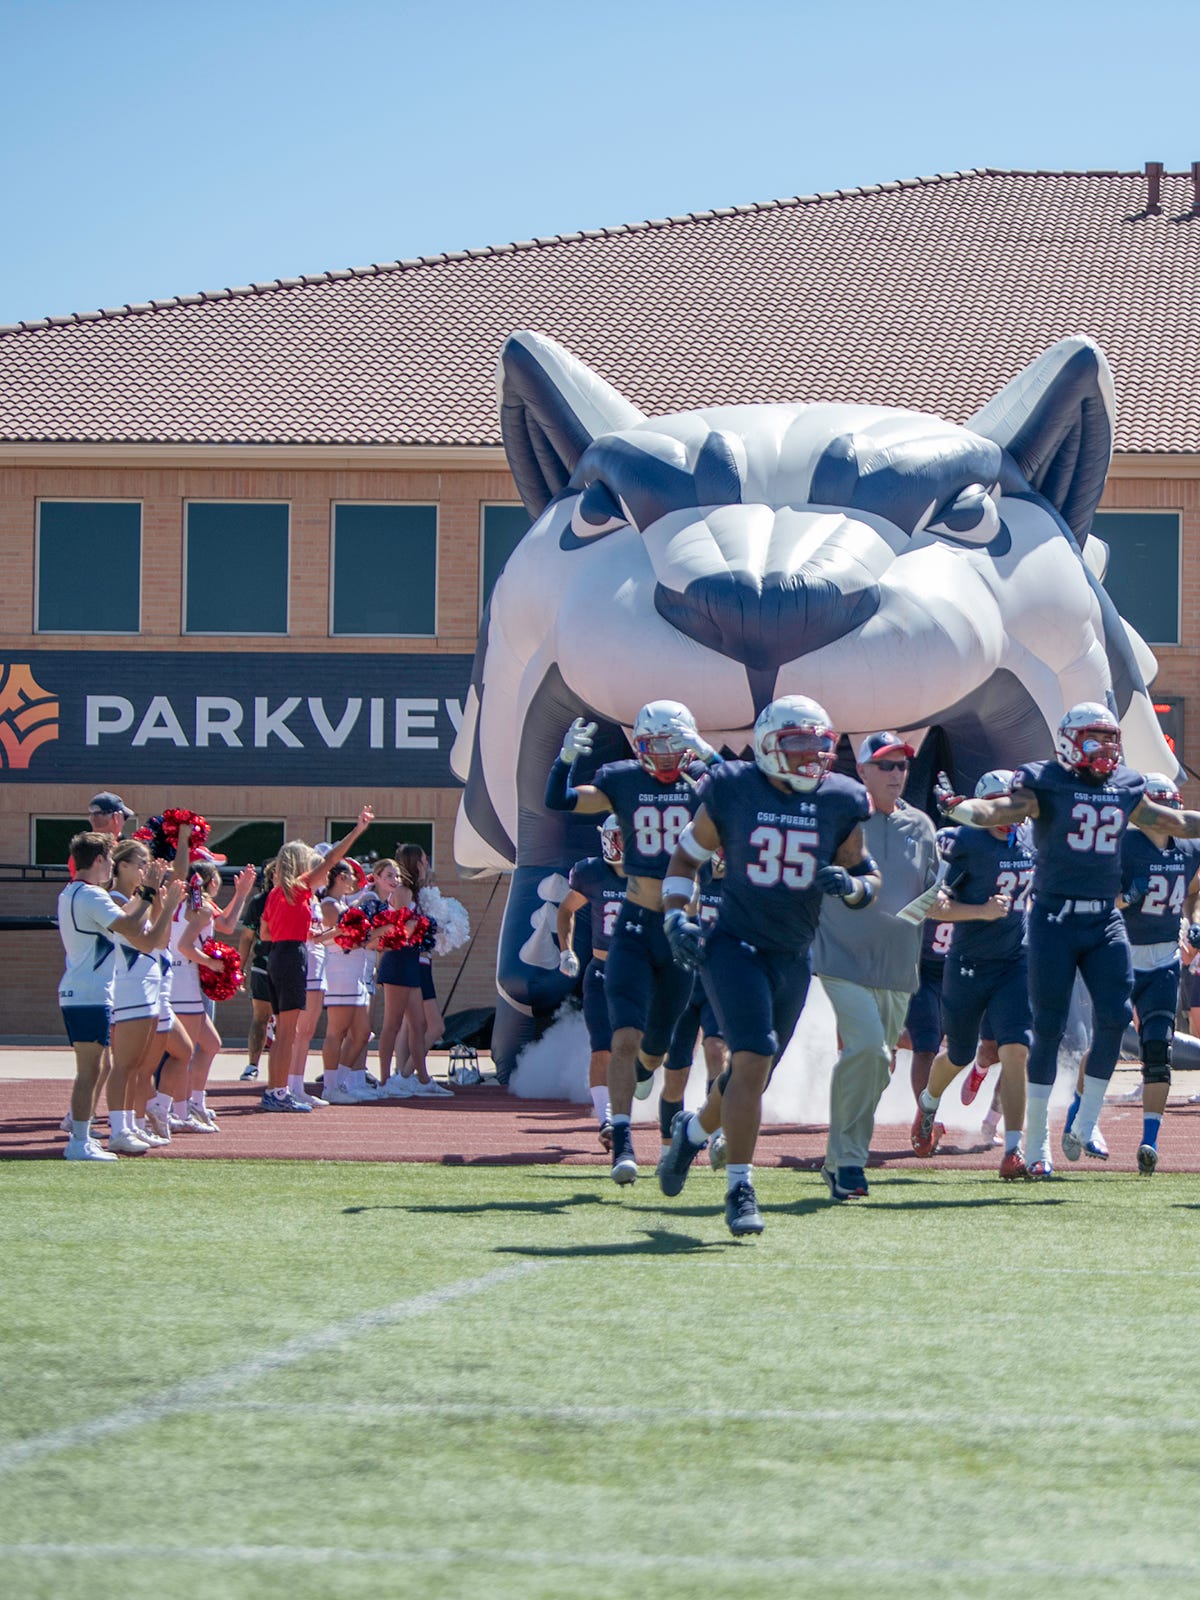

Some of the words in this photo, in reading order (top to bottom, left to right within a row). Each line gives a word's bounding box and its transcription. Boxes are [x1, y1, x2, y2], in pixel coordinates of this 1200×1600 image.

[638, 793, 689, 802] CSU-PUEBLO
[1074, 791, 1120, 803] CSU-PUEBLO
[633, 805, 691, 857] 88
[757, 812, 817, 826] CSU-PUEBLO
[1067, 803, 1125, 855] 32
[746, 826, 819, 890] 35
[602, 890, 627, 898] CSU-PU
[995, 867, 1036, 912] 37
[1141, 874, 1186, 915] 24
[603, 900, 623, 937] 2
